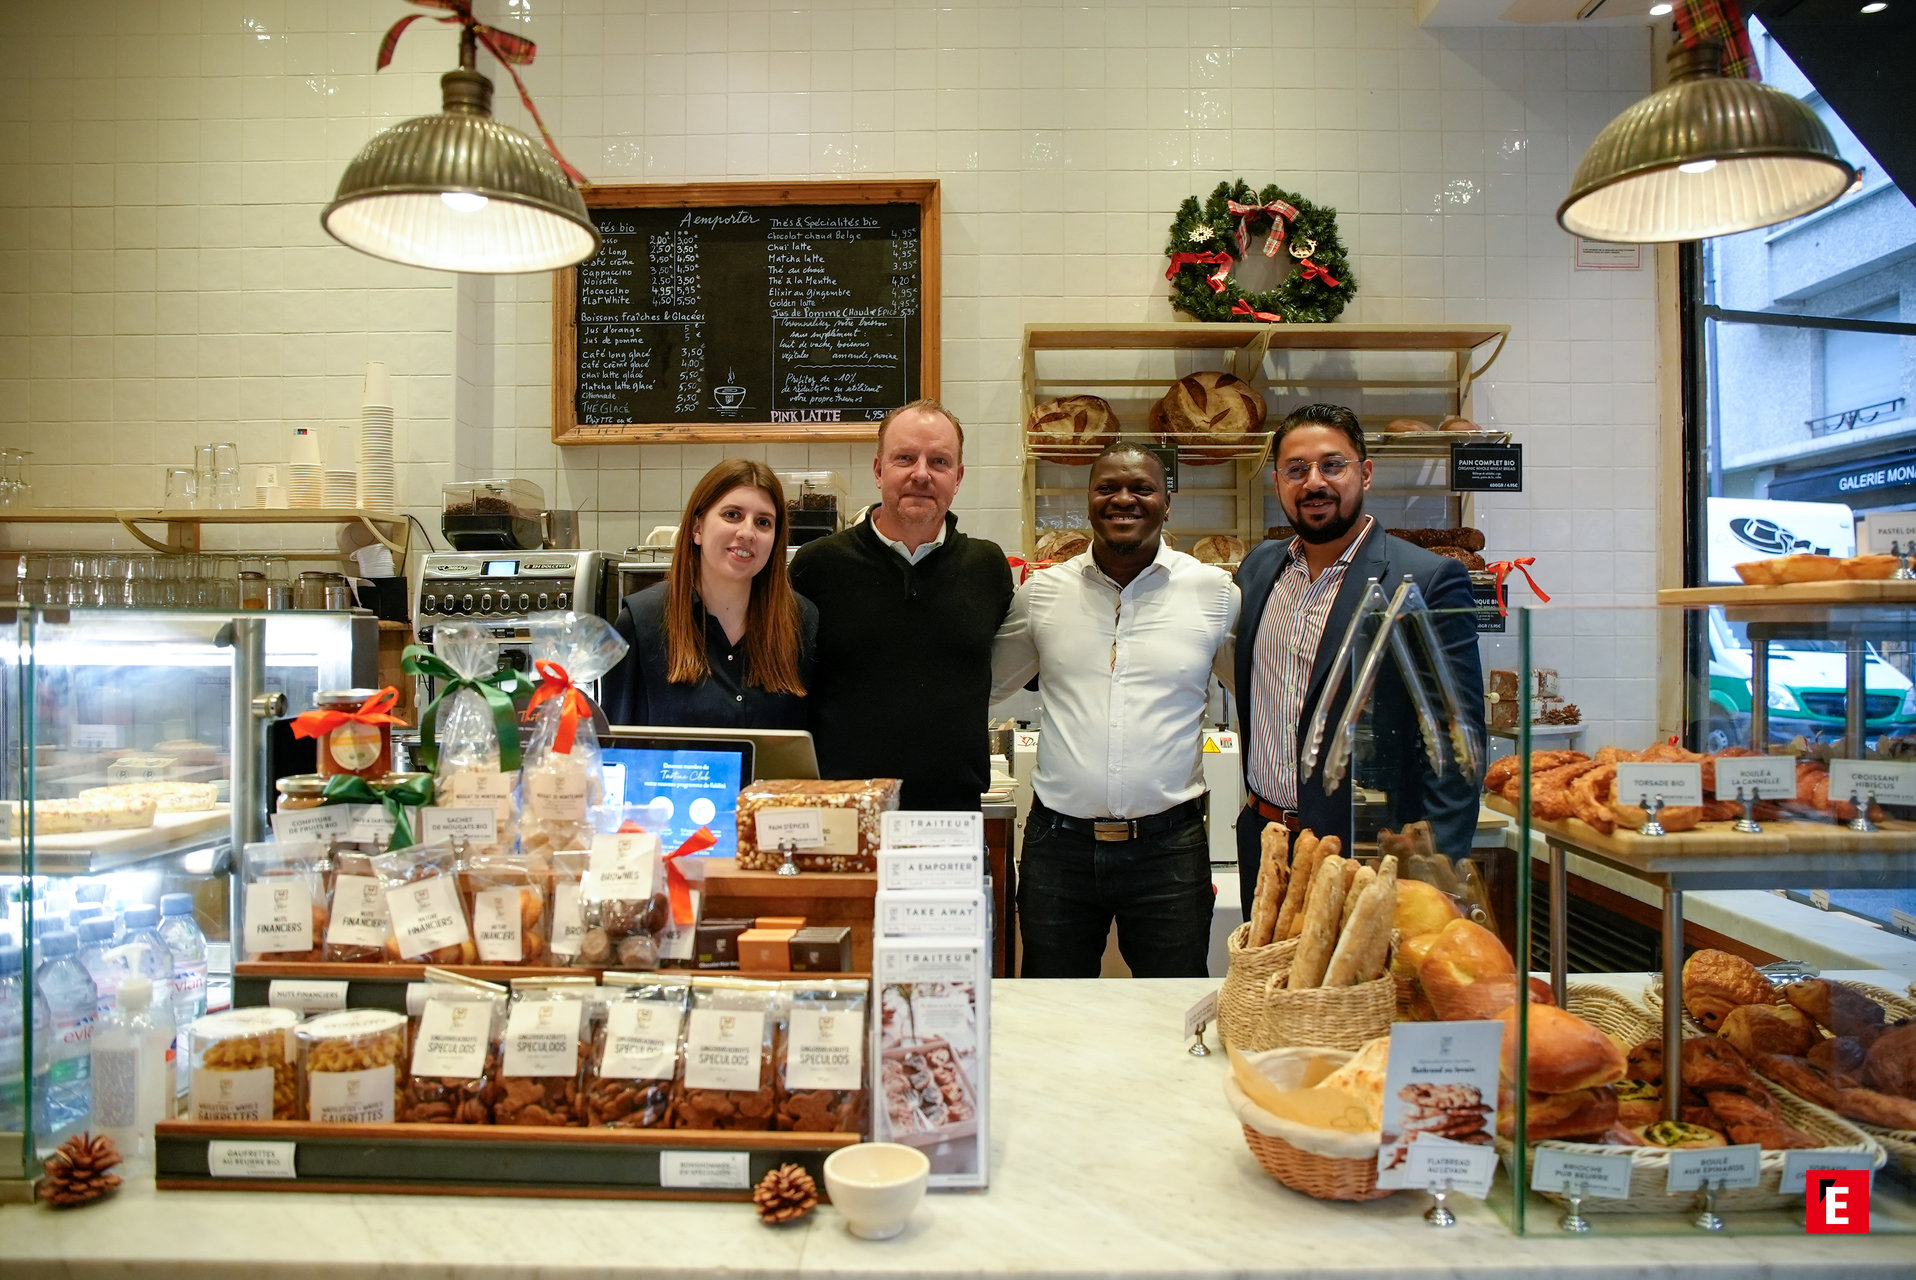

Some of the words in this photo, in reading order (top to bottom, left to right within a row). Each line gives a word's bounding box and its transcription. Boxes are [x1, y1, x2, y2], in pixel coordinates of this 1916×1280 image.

[619, 222, 635, 233] bio
[769, 217, 793, 227] Thés
[794, 216, 803, 227] &
[804, 216, 860, 229] Spécialités
[862, 217, 879, 226] bio
[767, 231, 802, 241] Chocolat
[804, 231, 832, 240] chaud
[836, 230, 862, 244] Belge
[792, 241, 813, 251] latte
[768, 254, 801, 264] Matcha
[804, 253, 826, 264] latte
[582, 268, 633, 280] Cappuccino
[768, 265, 784, 274] Thé
[583, 277, 619, 286] Noisette
[768, 275, 784, 285] Thé
[794, 275, 804, 285] la
[805, 275, 838, 286] Menthe
[768, 288, 793, 297] Elixir
[806, 287, 852, 301] gingembre
[604, 295, 631, 305] White
[769, 299, 796, 308] Golden
[800, 299, 817, 307] latte
[581, 311, 619, 322] Boissons
[621, 311, 661, 321] Fraîches
[672, 309, 705, 321] Glacées
[774, 308, 790, 318] Jus
[792, 307, 804, 317] de
[804, 306, 841, 318] Pomme
[585, 326, 600, 336] Jus
[602, 324, 642, 337] d'orange
[583, 337, 599, 345] Jus
[602, 335, 612, 345] de
[614, 337, 645, 346] pomme
[779, 339, 795, 349] lait
[798, 340, 808, 349] de
[582, 348, 606, 359] Café
[608, 349, 627, 362] long
[628, 347, 652, 362] glacé
[602, 369, 620, 379] latte
[819, 373, 831, 383] de
[581, 381, 612, 391] Matcha
[780, 384, 791, 394] de
[770, 410, 798, 423] PINK
[800, 410, 842, 422] LATTE
[1474, 459, 1503, 467] COMPLET
[1839, 470, 1886, 491] GALERIE
[1887, 465, 1916, 483] MON
[689, 770, 711, 781] Club
[1851, 773, 1900, 783] CROISSANT
[1743, 777, 1780, 785] CANNELLE
[1855, 781, 1895, 790] HIBISCUS
[291, 815, 332, 827] CONFITURE
[909, 819, 970, 827] TRAITEUR
[300, 823, 324, 833] FRUITS
[324, 821, 338, 829] BIO
[918, 863, 972, 871] EMPORTER
[905, 908, 935, 916] TAKE
[941, 908, 973, 916] AWAY
[256, 922, 303, 935] FINANCIERS
[407, 916, 454, 936] FINANCIERS
[905, 954, 972, 963] TRAITEUR
[296, 991, 338, 999] FINANCIERS
[427, 1042, 476, 1054] SPECULOOS
[517, 1041, 567, 1053] SPECULOOS
[698, 1053, 750, 1066] SPECULOOS
[799, 1053, 850, 1065] SPECULOOS
[227, 1150, 276, 1158] GAUFRETTES
[1427, 1158, 1471, 1167] FLATBREAD
[1701, 1156, 1729, 1166] ROULÉ
[1563, 1163, 1603, 1173] BRIOCHE
[1684, 1168, 1701, 1176] AUX
[1555, 1169, 1573, 1177] PUR
[1574, 1172, 1609, 1181] BEURRE
